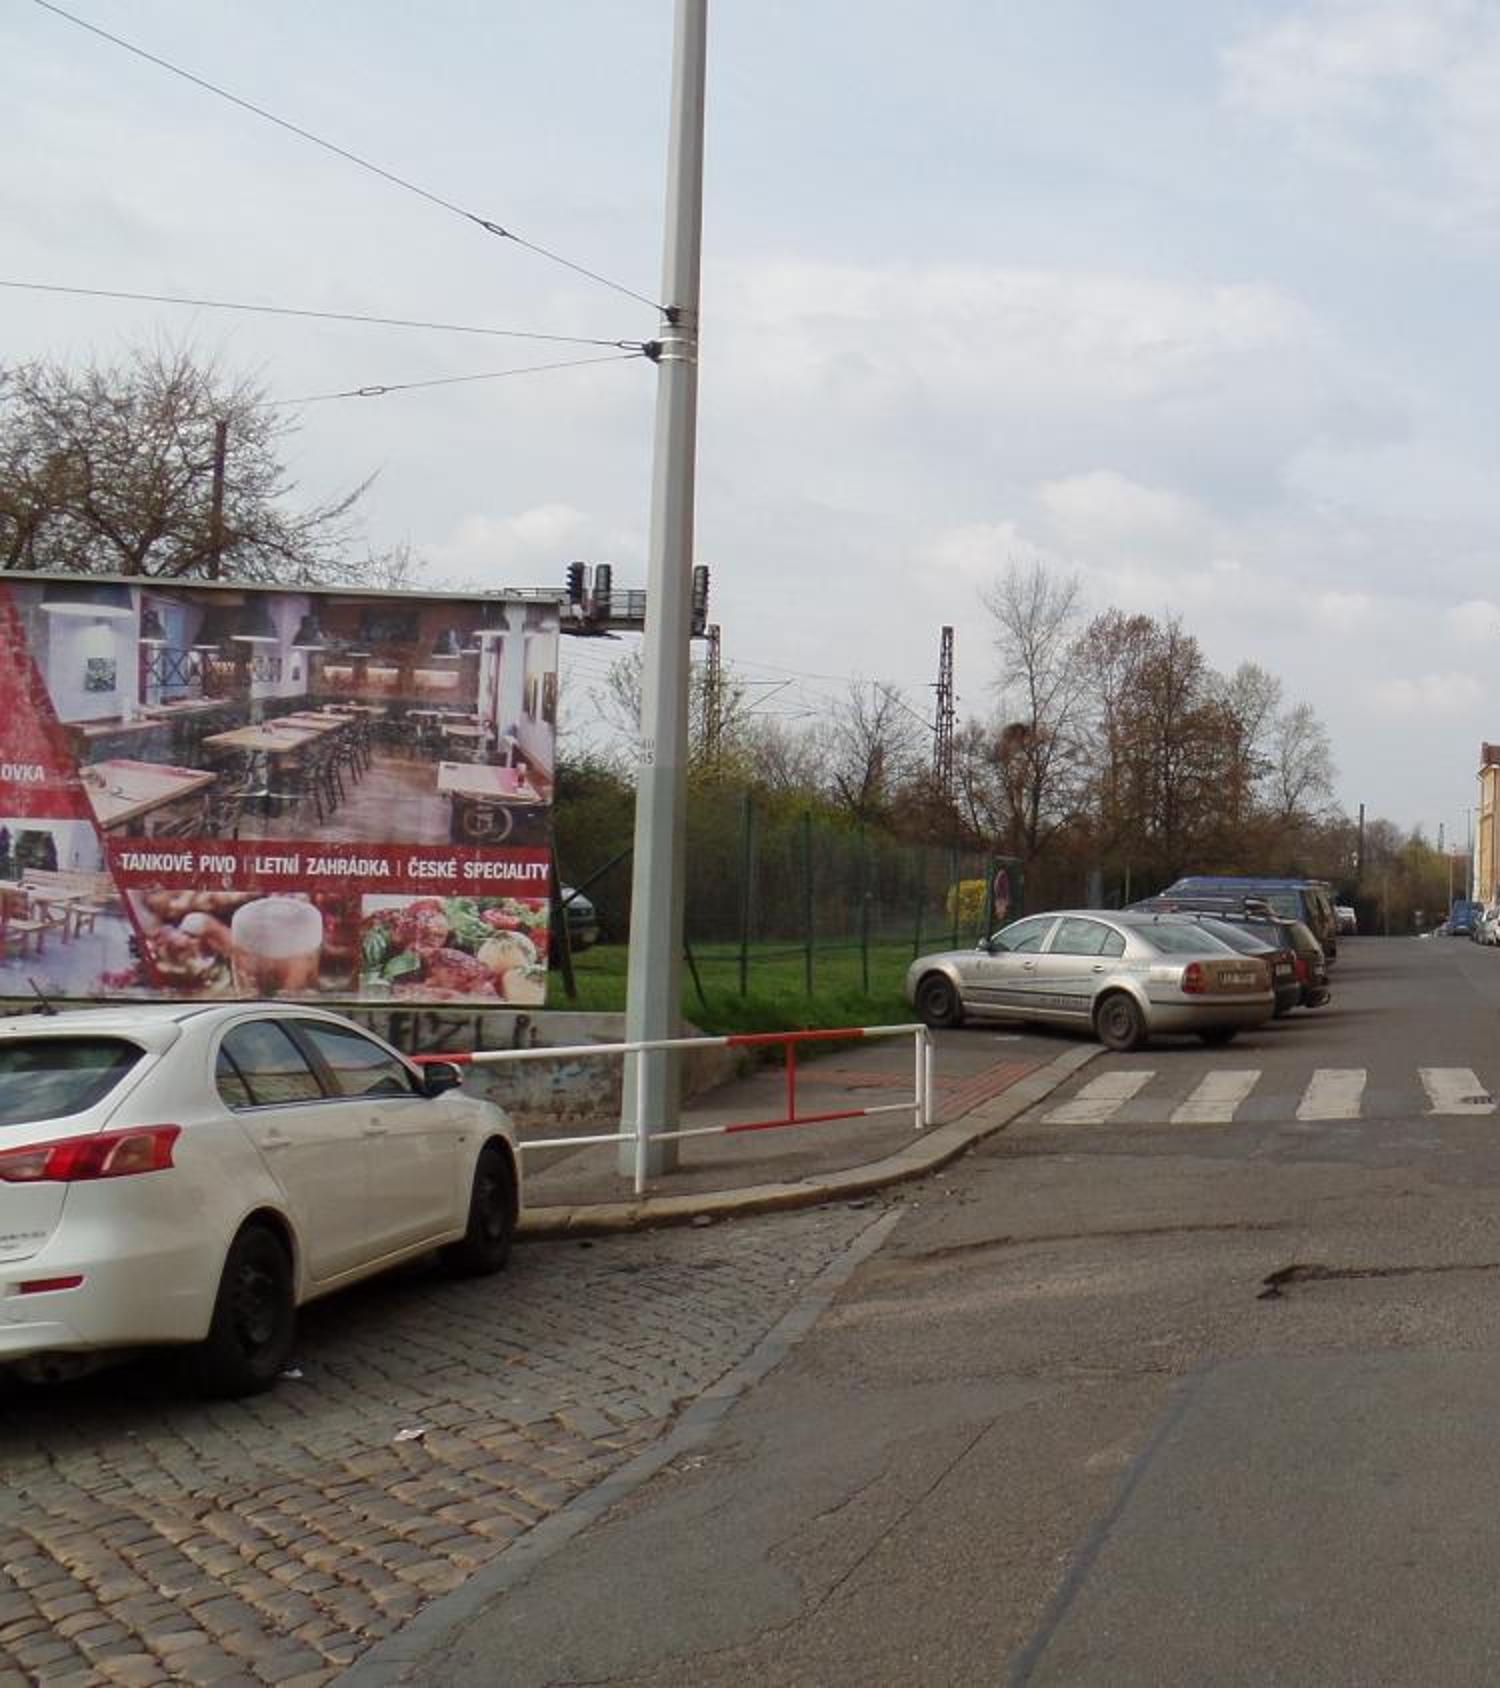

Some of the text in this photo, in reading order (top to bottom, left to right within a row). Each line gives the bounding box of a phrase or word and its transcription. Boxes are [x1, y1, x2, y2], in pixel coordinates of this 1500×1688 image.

[119, 851, 549, 880] TANKOVÉ PIVO LETNÍ ZAHRÁDKA ČESKÉ SPECIALITY
